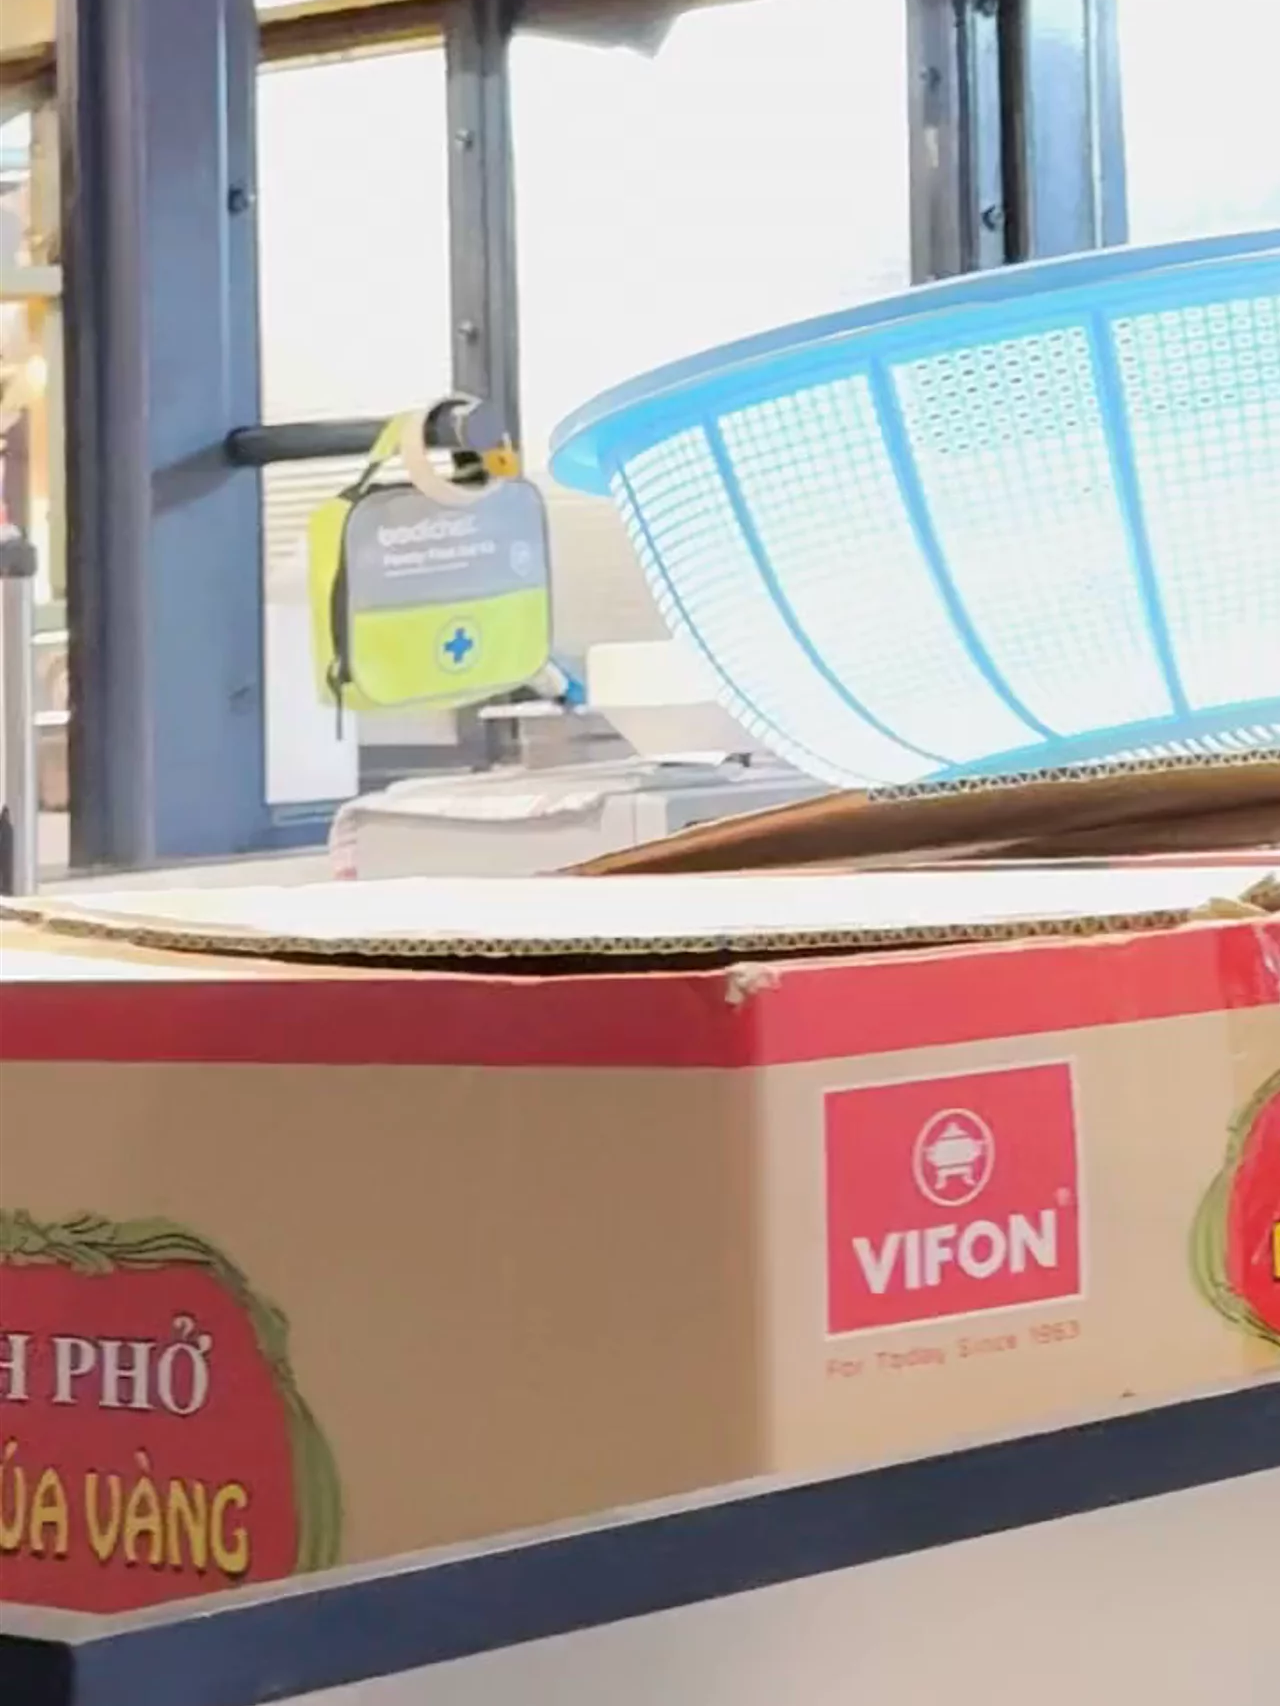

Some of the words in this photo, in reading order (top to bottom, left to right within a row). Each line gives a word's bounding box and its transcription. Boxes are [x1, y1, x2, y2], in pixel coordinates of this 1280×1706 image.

[852, 1208, 1058, 1295] VIFON
[52, 1316, 212, 1416] PHỞ
[84, 1448, 250, 1575] VÀNG
